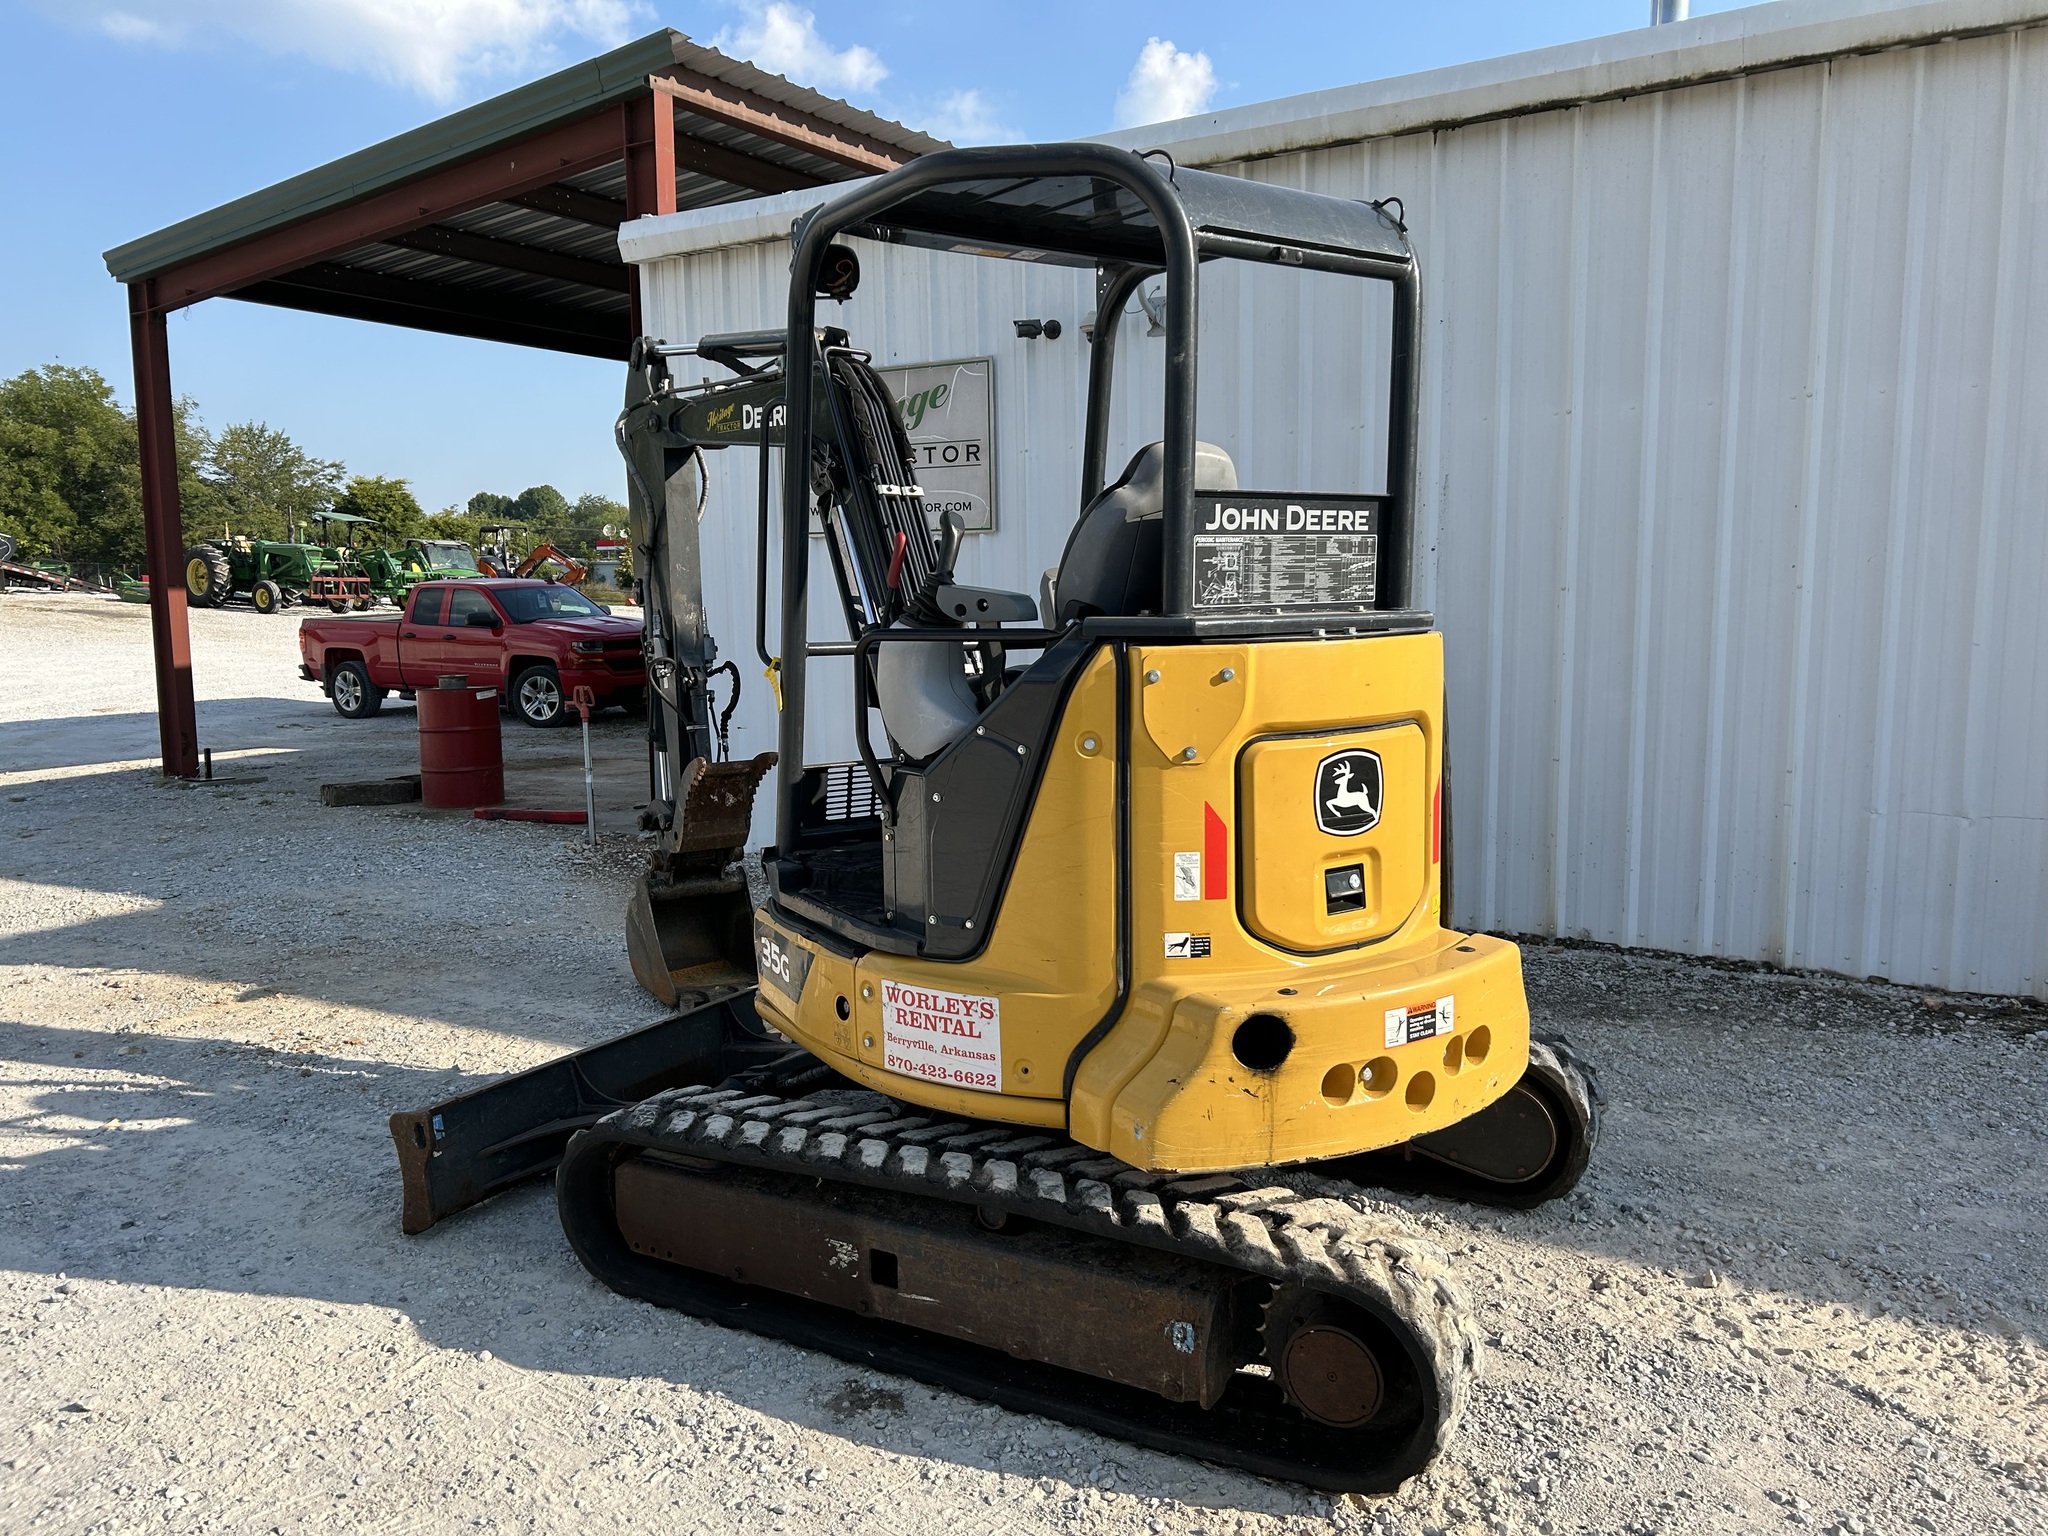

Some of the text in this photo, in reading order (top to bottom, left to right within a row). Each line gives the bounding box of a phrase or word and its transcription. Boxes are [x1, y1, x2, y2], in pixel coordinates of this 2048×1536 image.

[742, 404, 787, 430] DER
[912, 444, 981, 464] TOR
[923, 502, 972, 513] OR.COM
[1205, 503, 1370, 532] JOHN DEERE
[761, 936, 790, 983] 35G
[885, 985, 995, 1020] WORLEY'S
[1412, 1002, 1436, 1012] WARNING
[895, 1007, 982, 1039] RENTAL
[887, 1031, 996, 1062] Berryville, Arkansas
[887, 1054, 997, 1088] 870-423-6622
